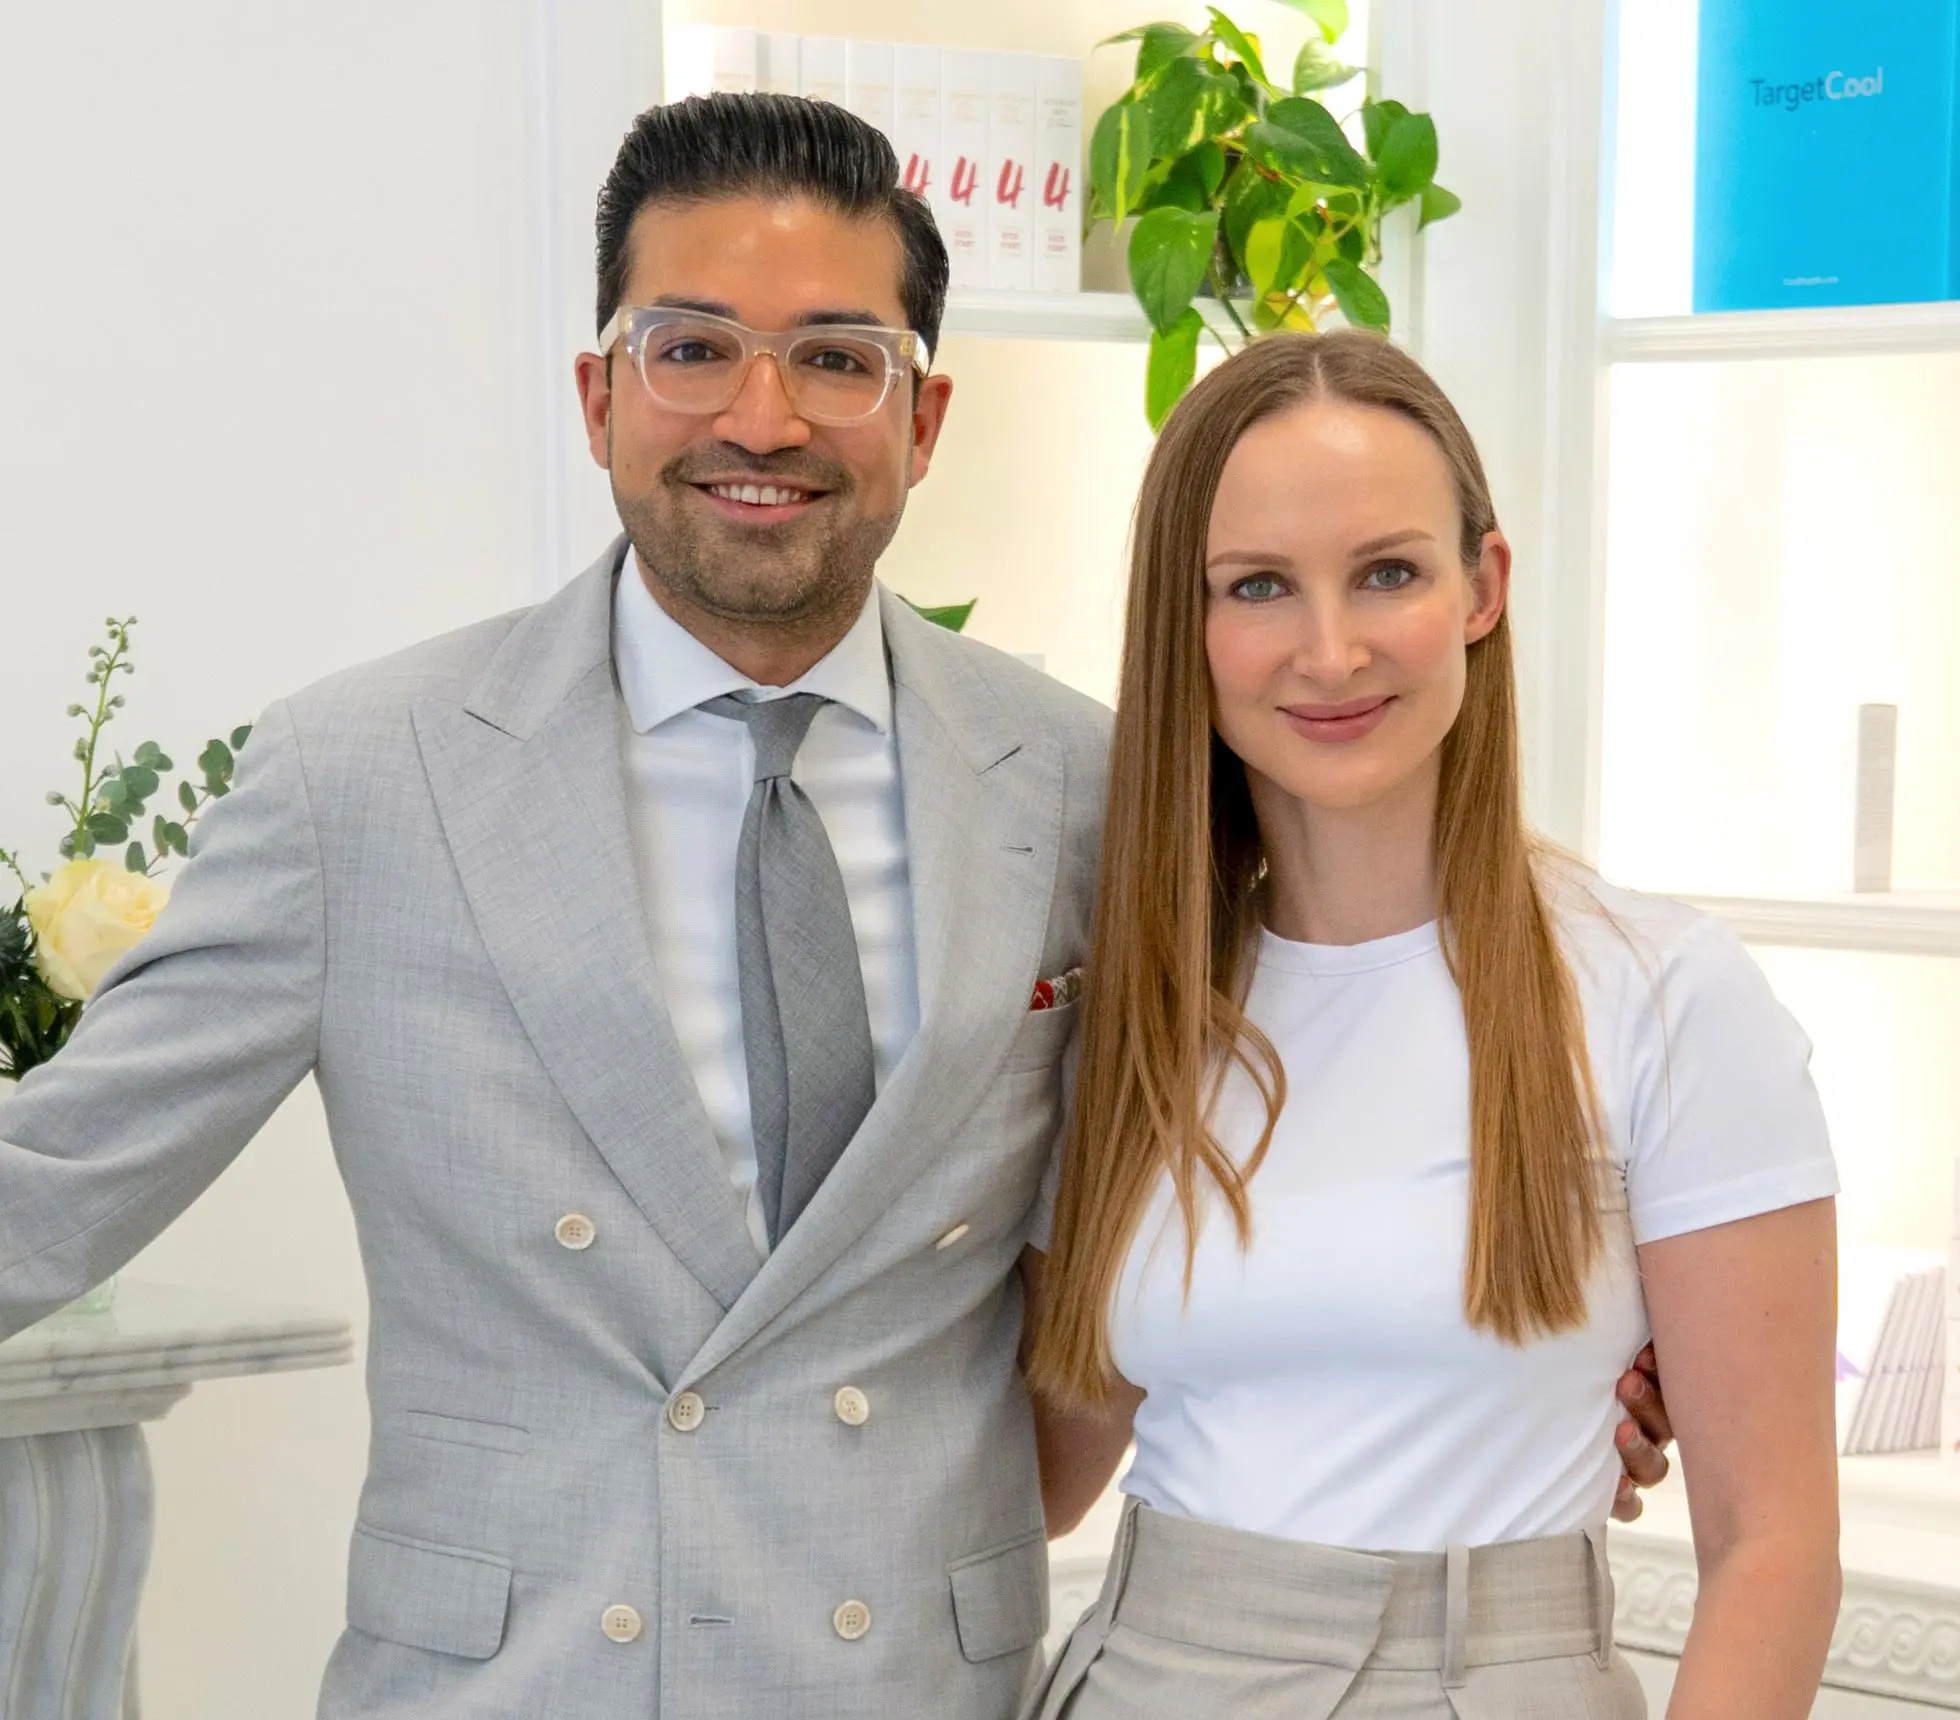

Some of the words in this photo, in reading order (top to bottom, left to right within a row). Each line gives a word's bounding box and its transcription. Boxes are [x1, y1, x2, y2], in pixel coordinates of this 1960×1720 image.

[1749, 66, 1884, 112] TargetCool
[950, 156, 979, 207] 4
[996, 159, 1025, 209] 4
[1043, 162, 1072, 212] 4
